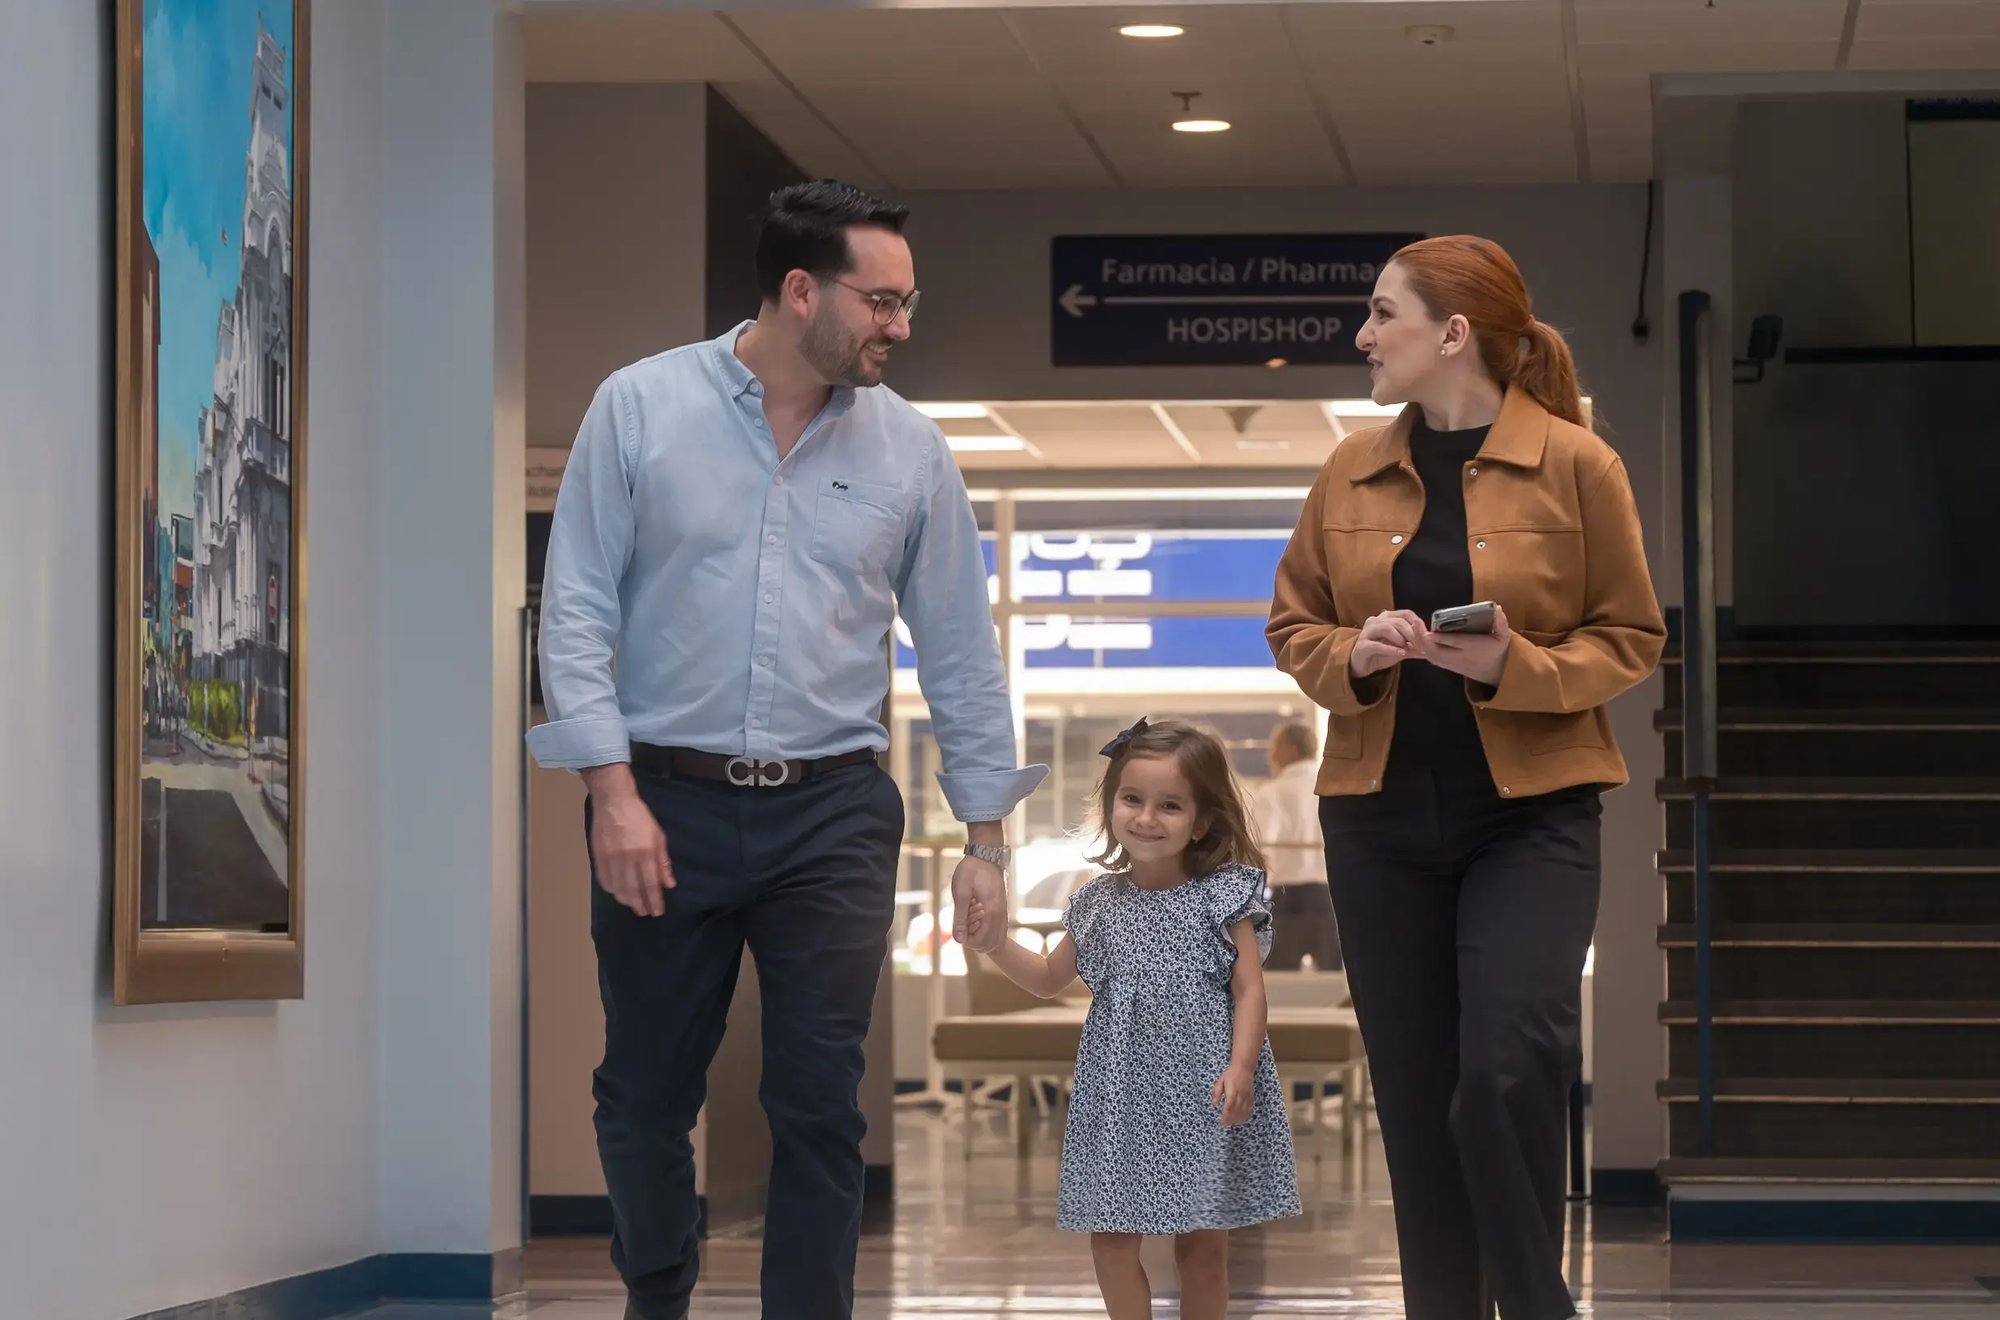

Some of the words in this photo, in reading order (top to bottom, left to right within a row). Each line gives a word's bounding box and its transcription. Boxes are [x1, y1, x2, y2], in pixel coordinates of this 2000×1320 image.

[1101, 256, 1236, 284] Farmacia
[1241, 257, 1255, 283] /
[1166, 316, 1342, 343] HOSPISHOP
